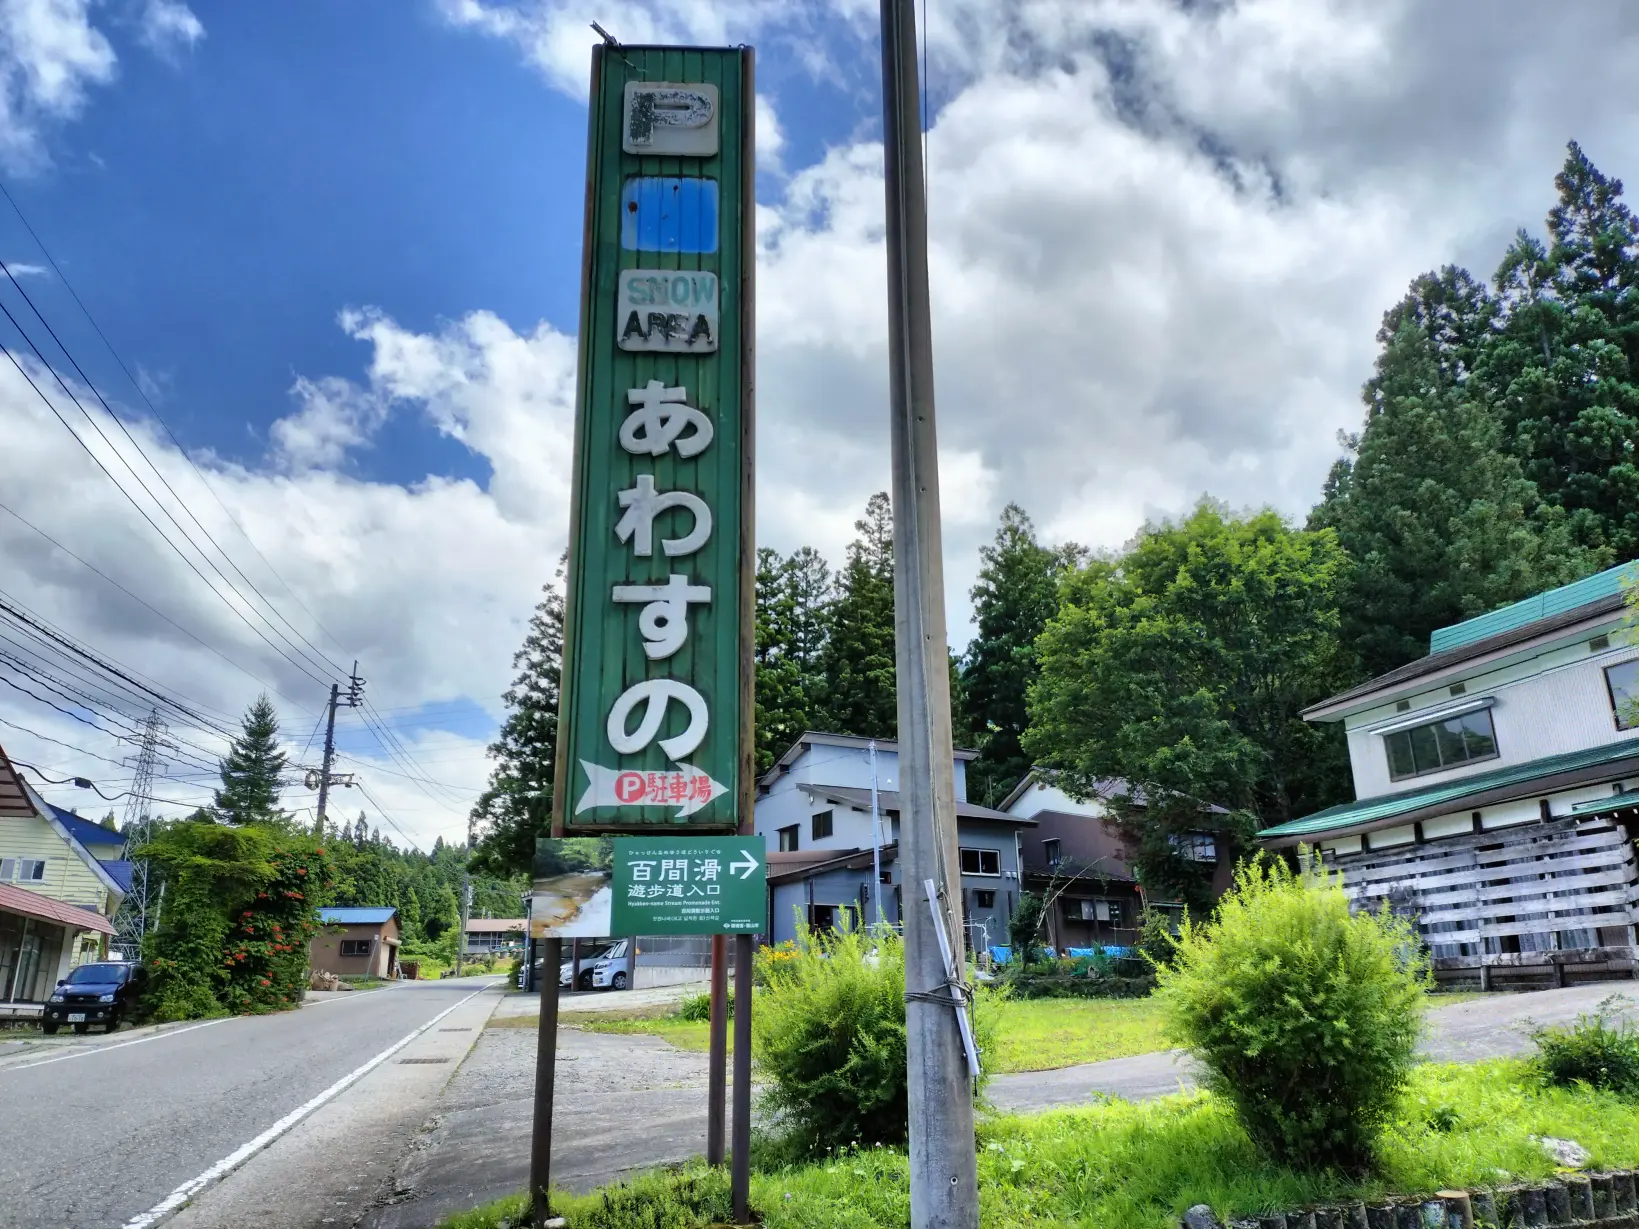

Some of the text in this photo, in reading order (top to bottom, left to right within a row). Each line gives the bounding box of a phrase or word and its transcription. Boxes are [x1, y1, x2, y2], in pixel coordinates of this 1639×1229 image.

[630, 89, 714, 146] P
[626, 275, 716, 307] SNOW
[620, 310, 714, 344] AREA
[607, 379, 714, 762] あわすの
[627, 858, 722, 882] 百間滑
[627, 883, 721, 899] 遊歩道入口
